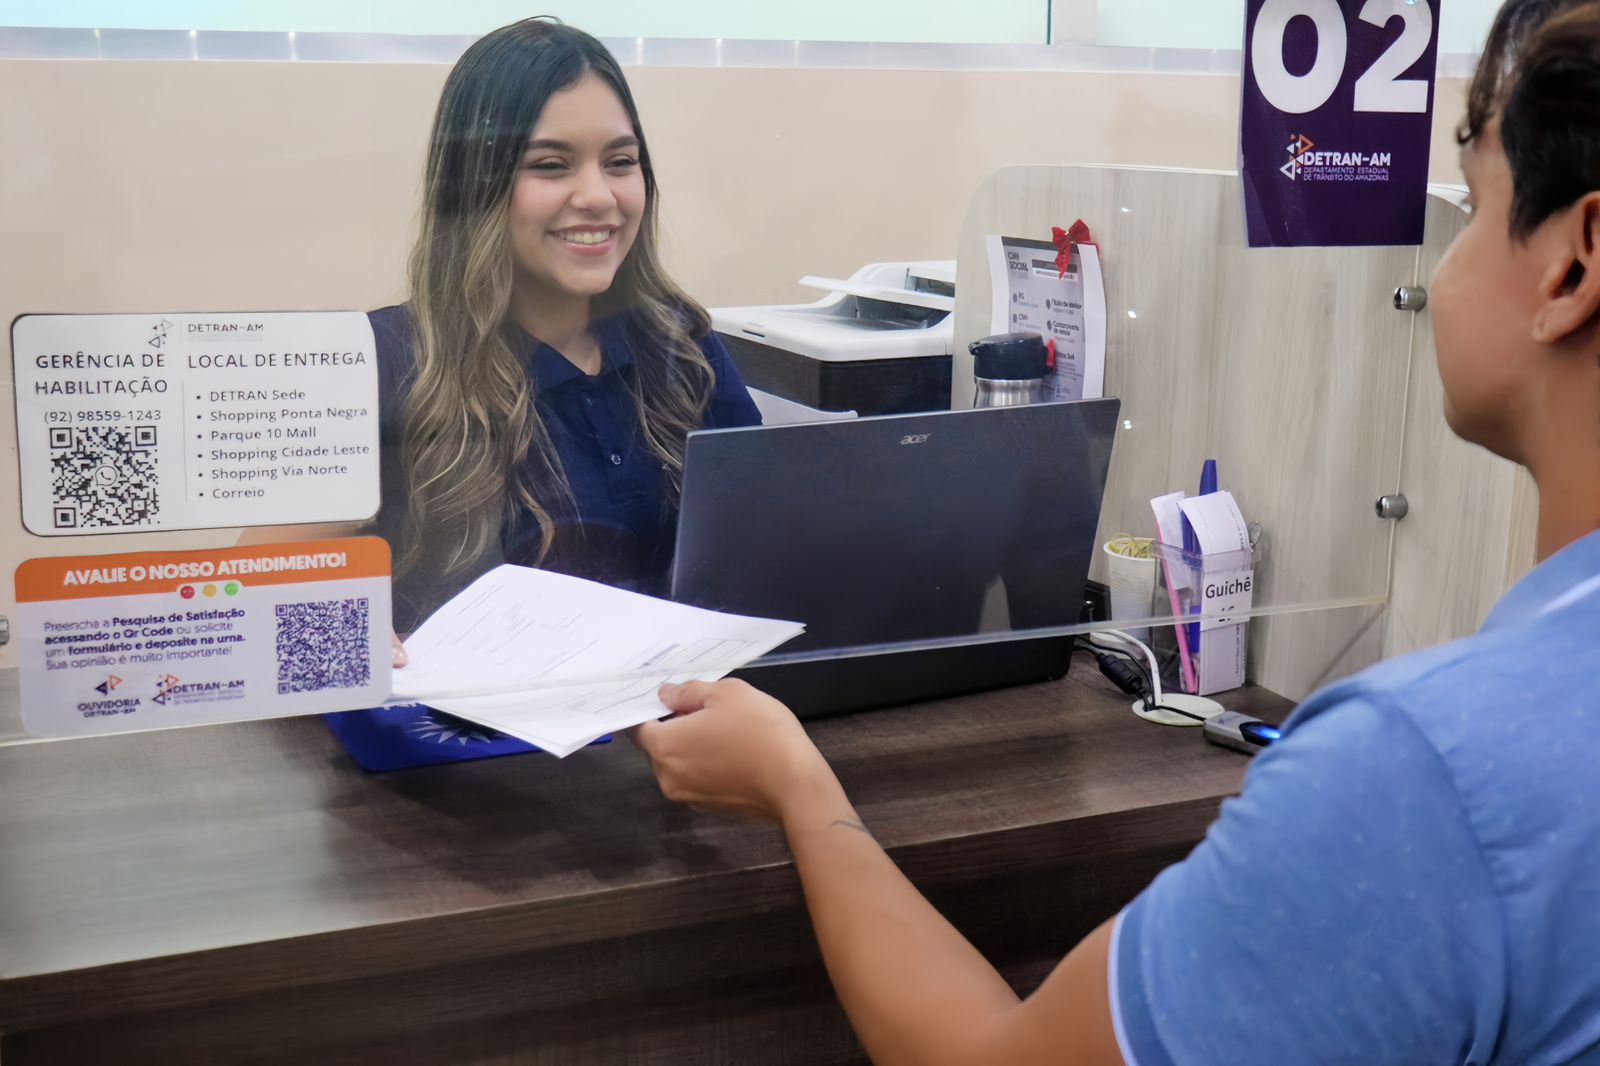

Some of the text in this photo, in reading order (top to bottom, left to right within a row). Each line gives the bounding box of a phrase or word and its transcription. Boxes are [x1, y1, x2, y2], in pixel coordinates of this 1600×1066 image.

[1251, 0, 1433, 114] 02
[1304, 152, 1391, 166] DETRAN-AM
[188, 323, 264, 333] DETRAN-AM
[36, 351, 166, 369] GERÊNCIA DE
[188, 351, 367, 369] LOCAL DE ENTREGA
[35, 376, 168, 398] HABILITAÇÃO
[210, 388, 306, 402] DETRAN Sede
[44, 410, 161, 424] (92) 98559-1243
[210, 407, 368, 423] Shopping Ponta Negra
[211, 427, 317, 443] Parque 10 Mall
[211, 445, 370, 463] Shopping Cidade Leste
[211, 464, 348, 482] Shopping Via Norte
[212, 487, 265, 499] Correio
[63, 552, 348, 587] AVALIE O NOSSO ATENDIMENTO!
[1205, 577, 1252, 599] Guichê
[43, 619, 100, 632] Preencha
[112, 615, 165, 627] Pesquisa
[168, 612, 183, 623] de
[186, 608, 245, 621] Satisfação
[44, 630, 110, 645] acessando
[113, 632, 121, 640] o
[141, 626, 174, 637] Code
[176, 627, 191, 635] ou
[194, 622, 233, 634] solicite
[45, 649, 66, 658] um
[69, 643, 132, 656] formulário
[145, 637, 198, 650] deposite
[200, 637, 214, 645] na
[216, 634, 246, 644] urna.
[46, 660, 68, 671] Sua
[71, 656, 116, 669] opinião
[130, 652, 163, 663] muito
[166, 646, 232, 661] importante!
[174, 680, 245, 694] DETRAN-AM
[77, 698, 141, 712] OUVIDORIA
